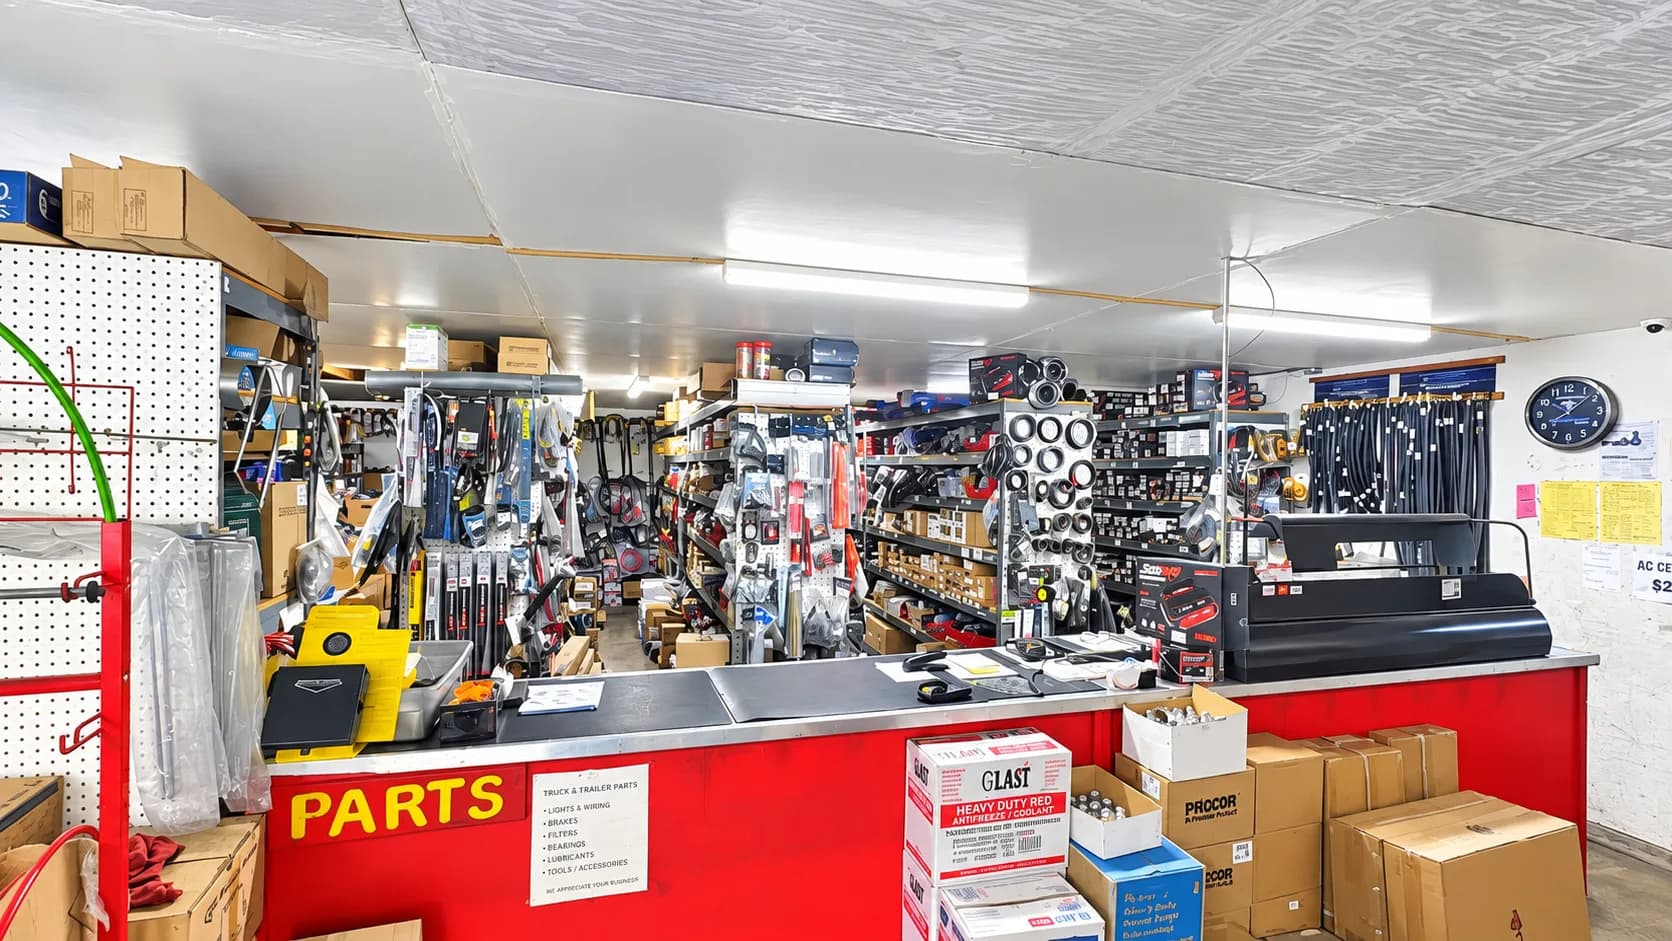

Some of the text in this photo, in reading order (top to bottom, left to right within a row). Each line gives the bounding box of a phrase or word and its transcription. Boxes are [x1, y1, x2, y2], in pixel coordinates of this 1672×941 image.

[1551, 388, 1559, 397] 11
[1564, 384, 1574, 393] 12
[1591, 394, 1598, 402] 2
[1596, 406, 1603, 415] 3
[1552, 431, 1558, 439] 7
[1580, 429, 1587, 438] 5
[1637, 560, 1672, 573] AC CE
[1652, 579, 1672, 593] $2
[982, 766, 1031, 792] GLAST
[544, 788, 569, 797] TRUCK
[579, 784, 612, 794] TRAILER
[613, 781, 638, 790] PARTS
[291, 775, 504, 840] PARTS
[548, 805, 575, 814] LIGHTS
[583, 802, 610, 811] WIRING
[956, 795, 1052, 816] HEAVY DUTY RED
[1185, 794, 1236, 816] PROCOR
[548, 817, 578, 827] BRAKES
[952, 811, 1006, 826] ANTIFREEZE
[1013, 806, 1054, 818] COOLANT
[548, 829, 578, 839] FILTERS
[547, 840, 586, 851] BEARINGS
[547, 851, 595, 863] LUBRICANTS
[548, 866, 572, 876] TOOLS
[578, 859, 628, 871] ACCESSORIES
[556, 883, 591, 893] APPRECIATE
